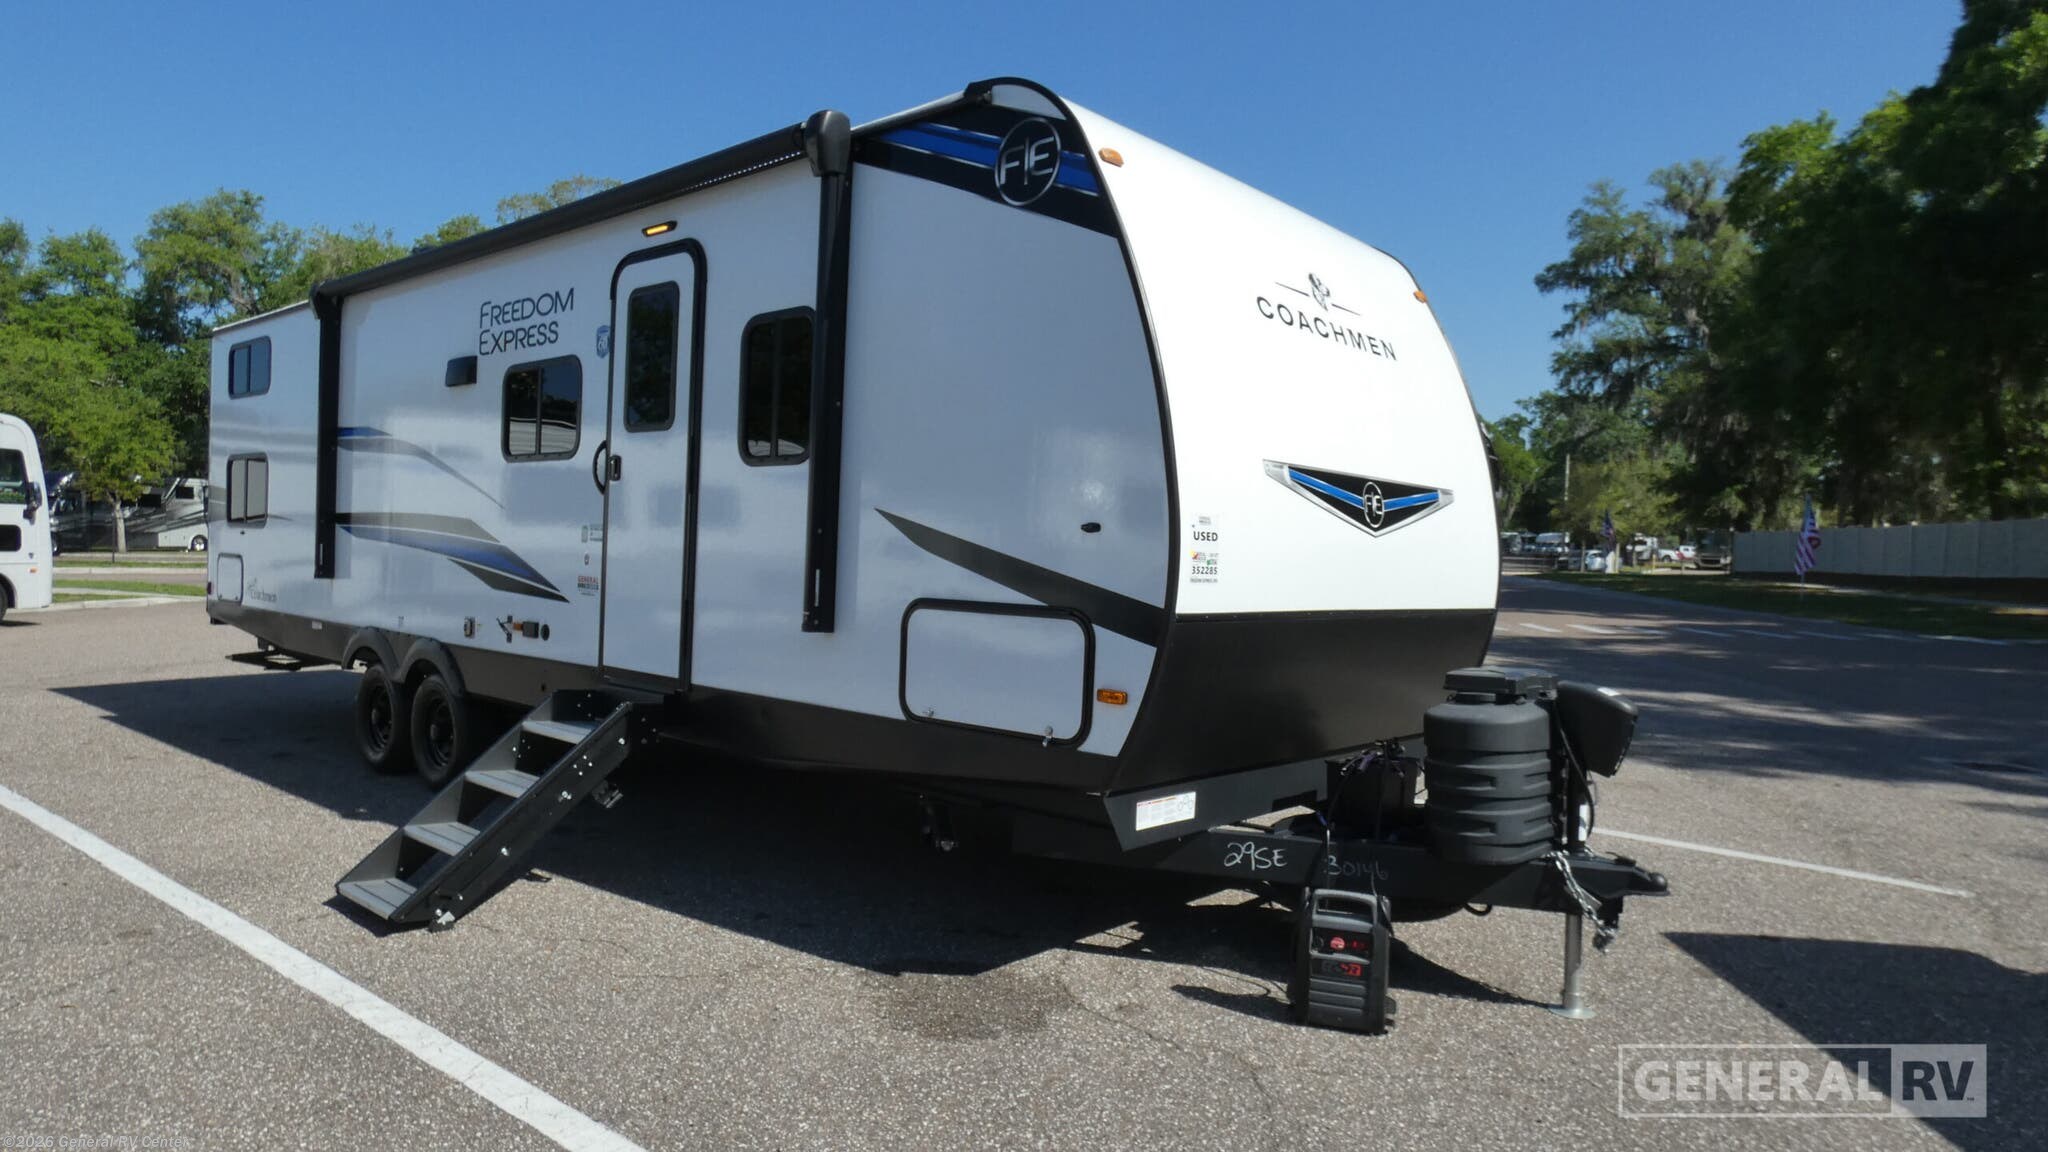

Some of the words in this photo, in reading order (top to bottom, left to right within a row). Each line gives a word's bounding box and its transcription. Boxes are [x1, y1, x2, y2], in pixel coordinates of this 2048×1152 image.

[480, 288, 575, 329] FREEDOM
[479, 321, 559, 356] EXPRESS
[1256, 296, 1398, 361] COACHMEN
[1193, 531, 1219, 542] USED
[1191, 565, 1218, 575] 352285
[1223, 841, 1288, 871] 29SE
